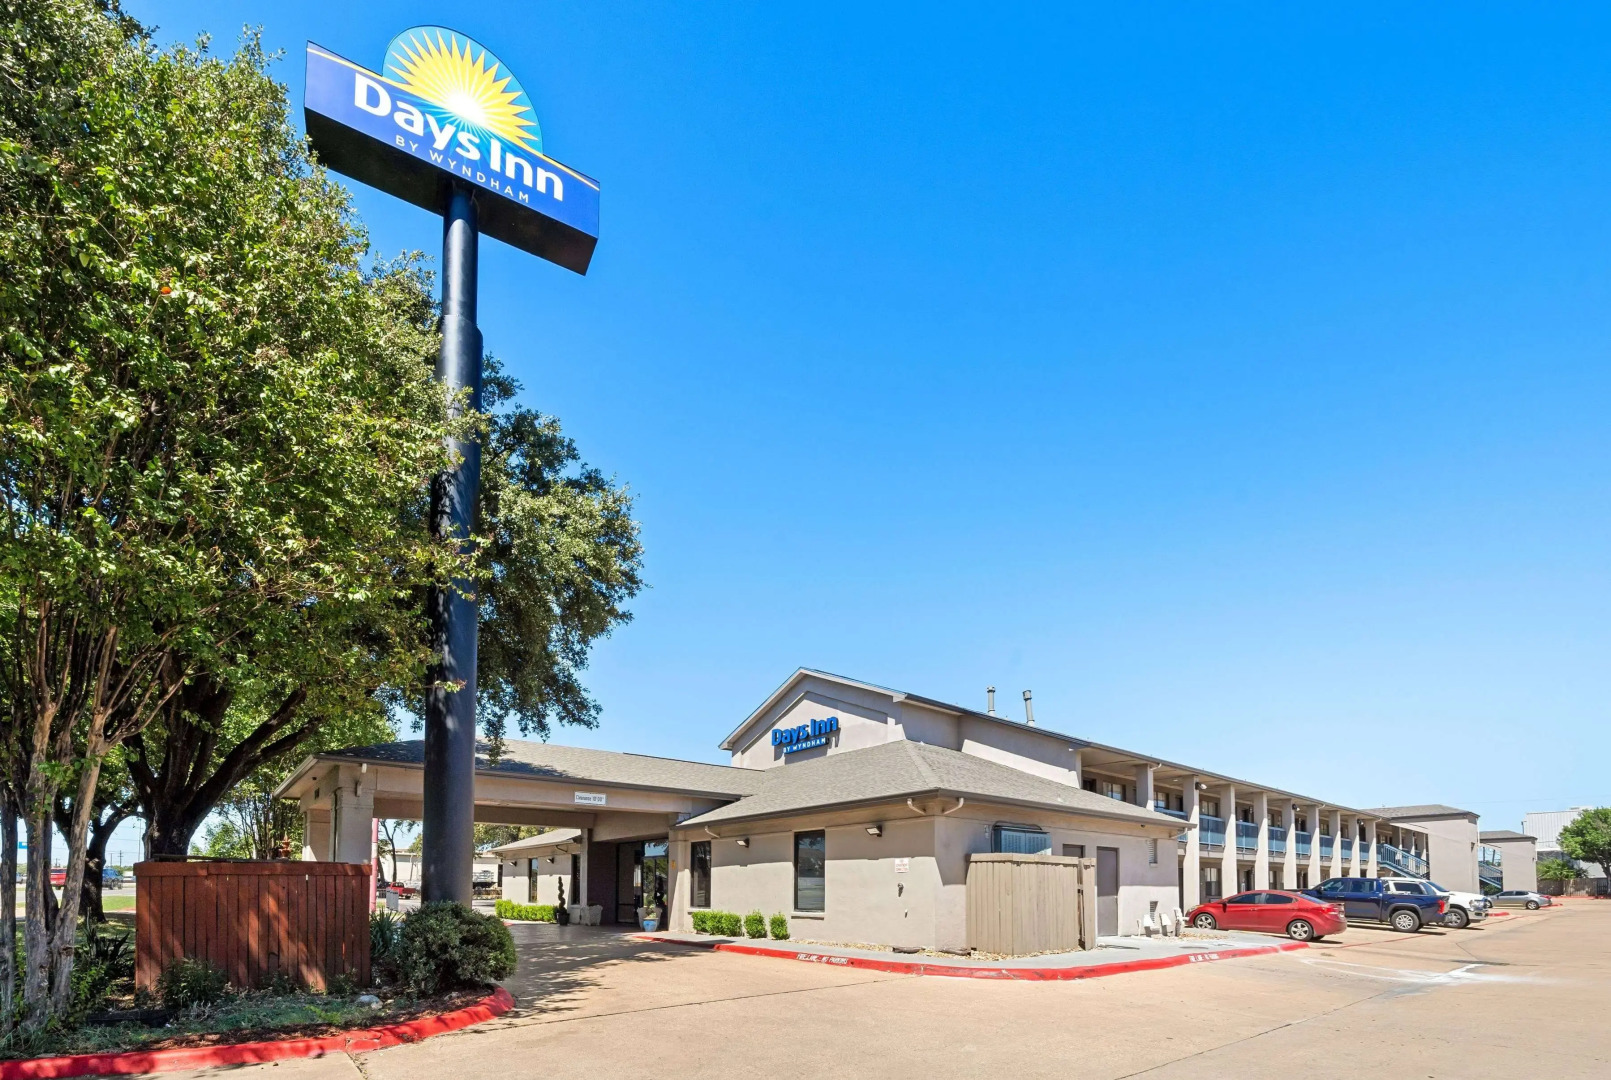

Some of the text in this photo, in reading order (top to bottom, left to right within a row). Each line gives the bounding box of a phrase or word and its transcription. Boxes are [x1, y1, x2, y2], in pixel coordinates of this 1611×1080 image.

[354, 72, 563, 202] Days Inn
[395, 134, 529, 203] BY WYNDHAM
[771, 716, 839, 746] Days Inn
[792, 737, 826, 751] WYNDHAM
